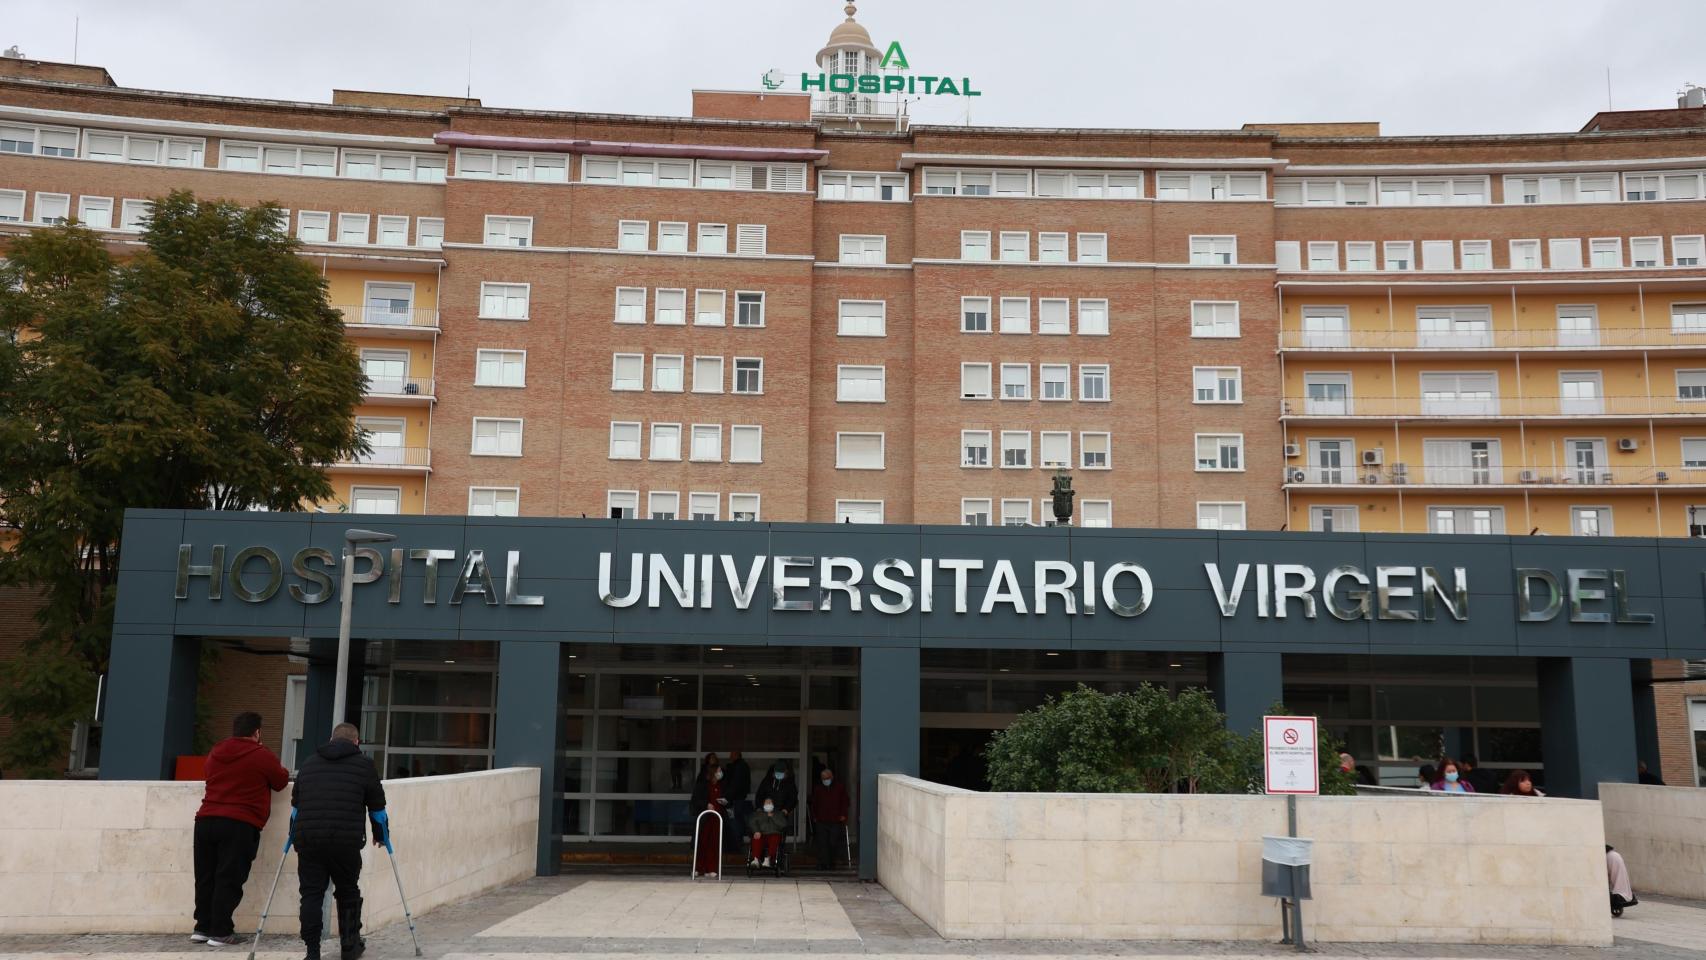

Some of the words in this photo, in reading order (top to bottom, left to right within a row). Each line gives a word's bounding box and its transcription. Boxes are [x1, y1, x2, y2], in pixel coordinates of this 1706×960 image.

[801, 72, 981, 96] HOSPITAL
[174, 543, 545, 606] HOSPITAL
[597, 551, 1154, 617] UNIVERSITARIO
[1204, 562, 1469, 622] VIRGEN
[1515, 566, 1656, 625] DEL
